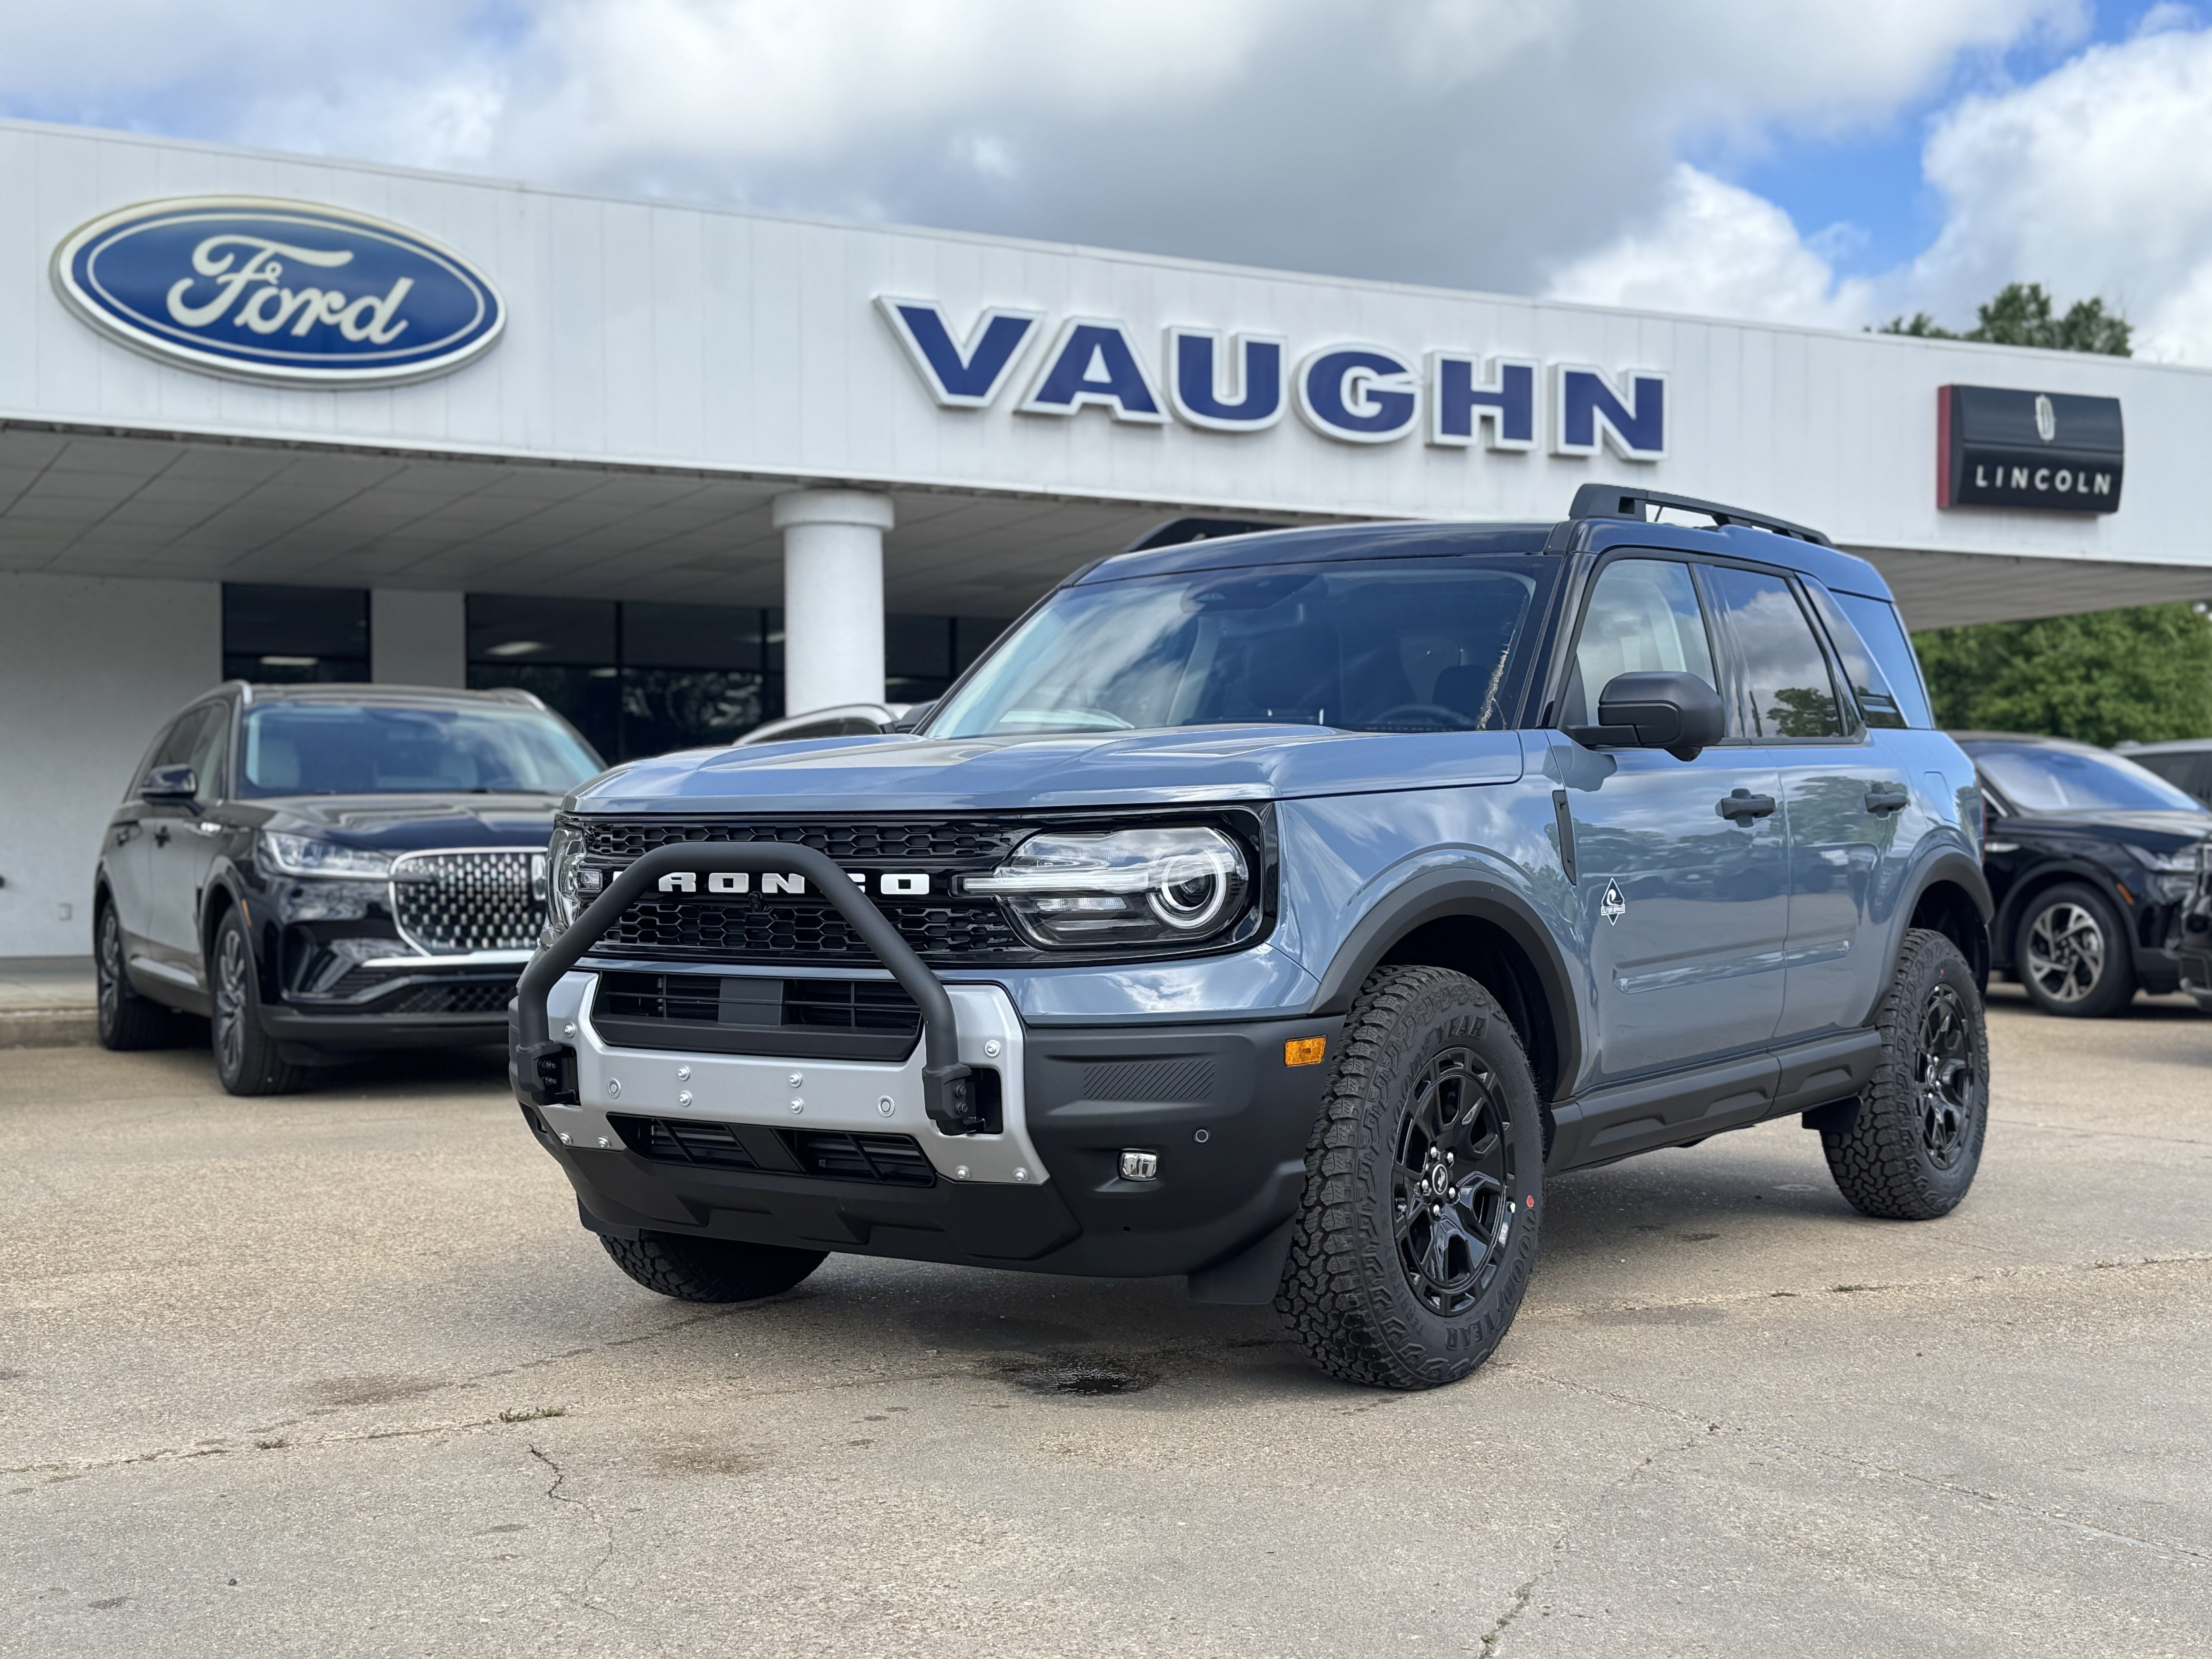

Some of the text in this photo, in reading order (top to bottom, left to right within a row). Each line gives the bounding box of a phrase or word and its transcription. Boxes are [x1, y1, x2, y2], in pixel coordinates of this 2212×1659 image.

[166, 234, 414, 345] Ford
[874, 296, 1669, 460] VAUGHN
[1976, 465, 2111, 495] LINCOLN
[613, 871, 930, 895] RONO
